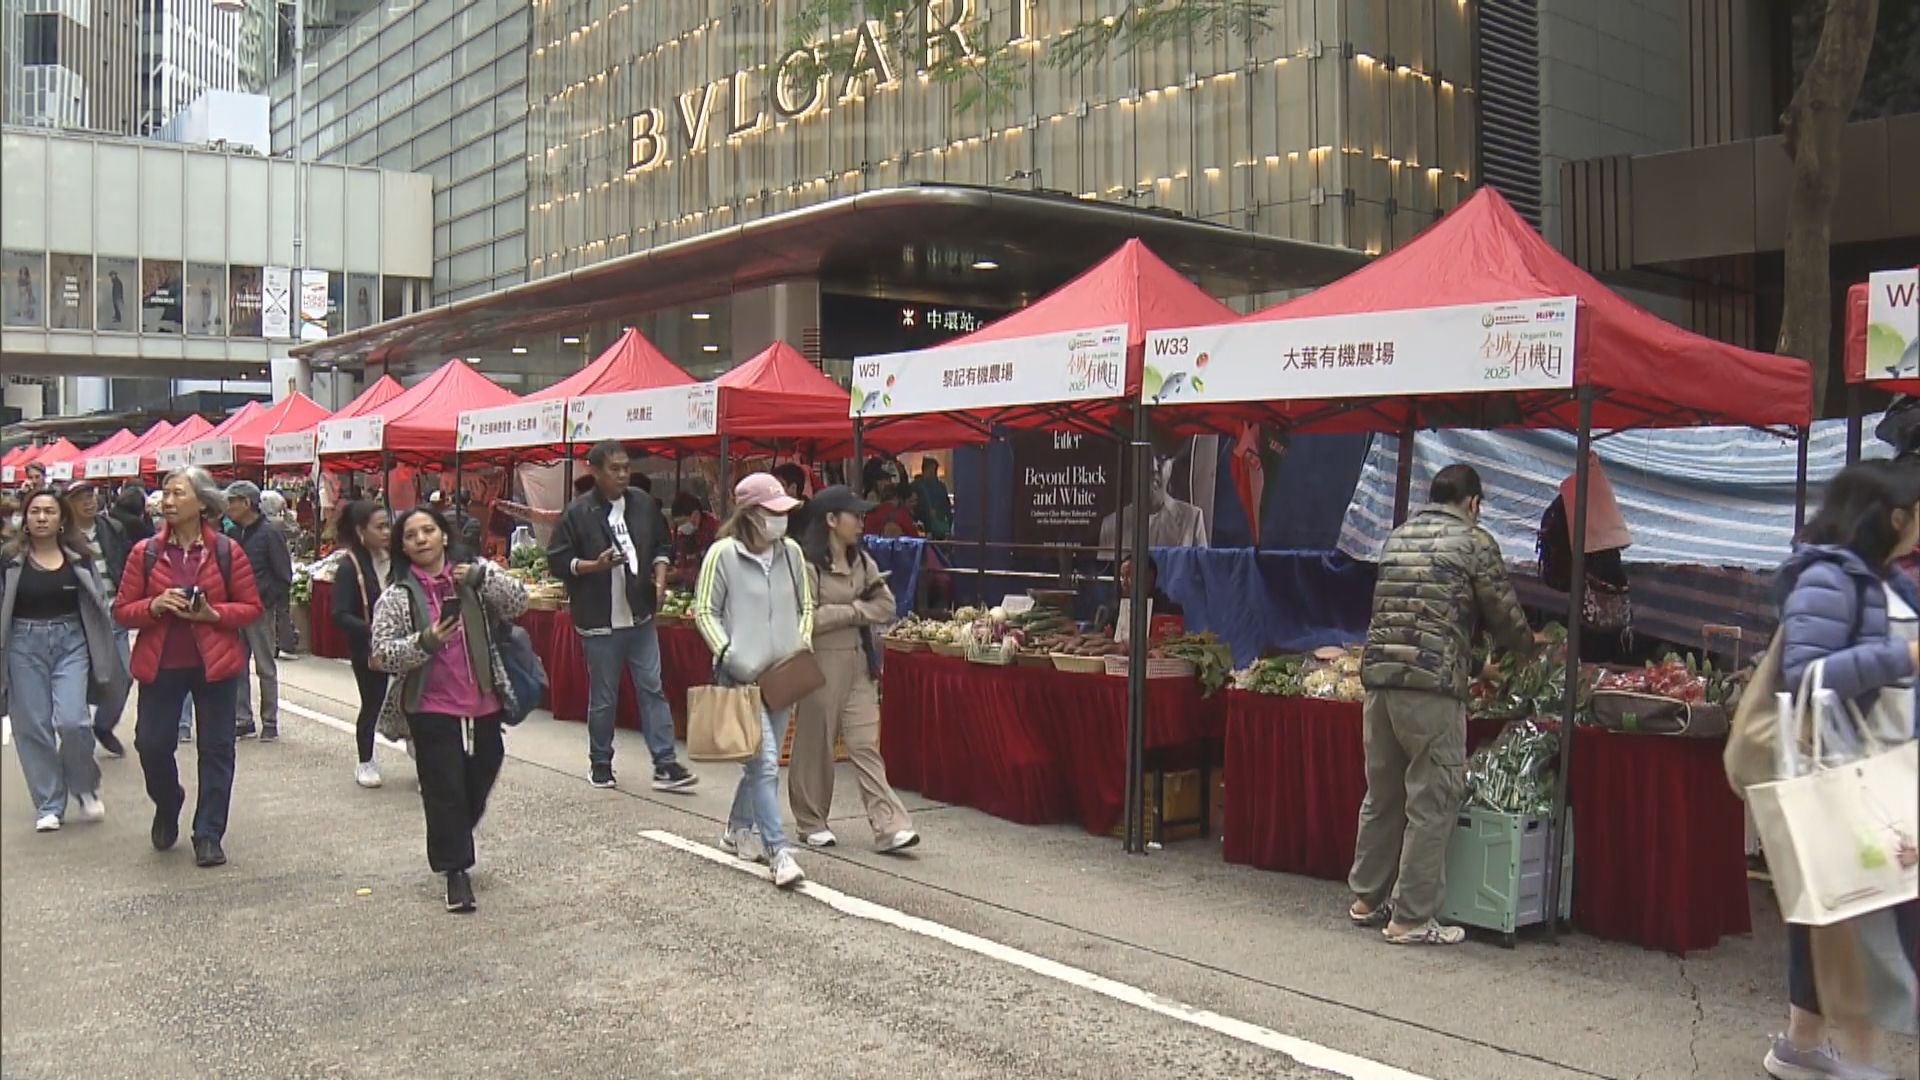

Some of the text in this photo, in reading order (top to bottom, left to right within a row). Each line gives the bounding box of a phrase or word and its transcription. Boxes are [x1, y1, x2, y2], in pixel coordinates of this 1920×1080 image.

[1886, 282, 1919, 307] W
[927, 308, 974, 331] 中環站
[1154, 338, 1189, 356] W33
[1283, 341, 1395, 371] 大葉有機農場
[859, 363, 880, 378] W31
[1484, 366, 1511, 379] 2025
[570, 400, 585, 414] W27
[1024, 464, 1107, 489] Beyond Black
[1033, 487, 1096, 506] and White
